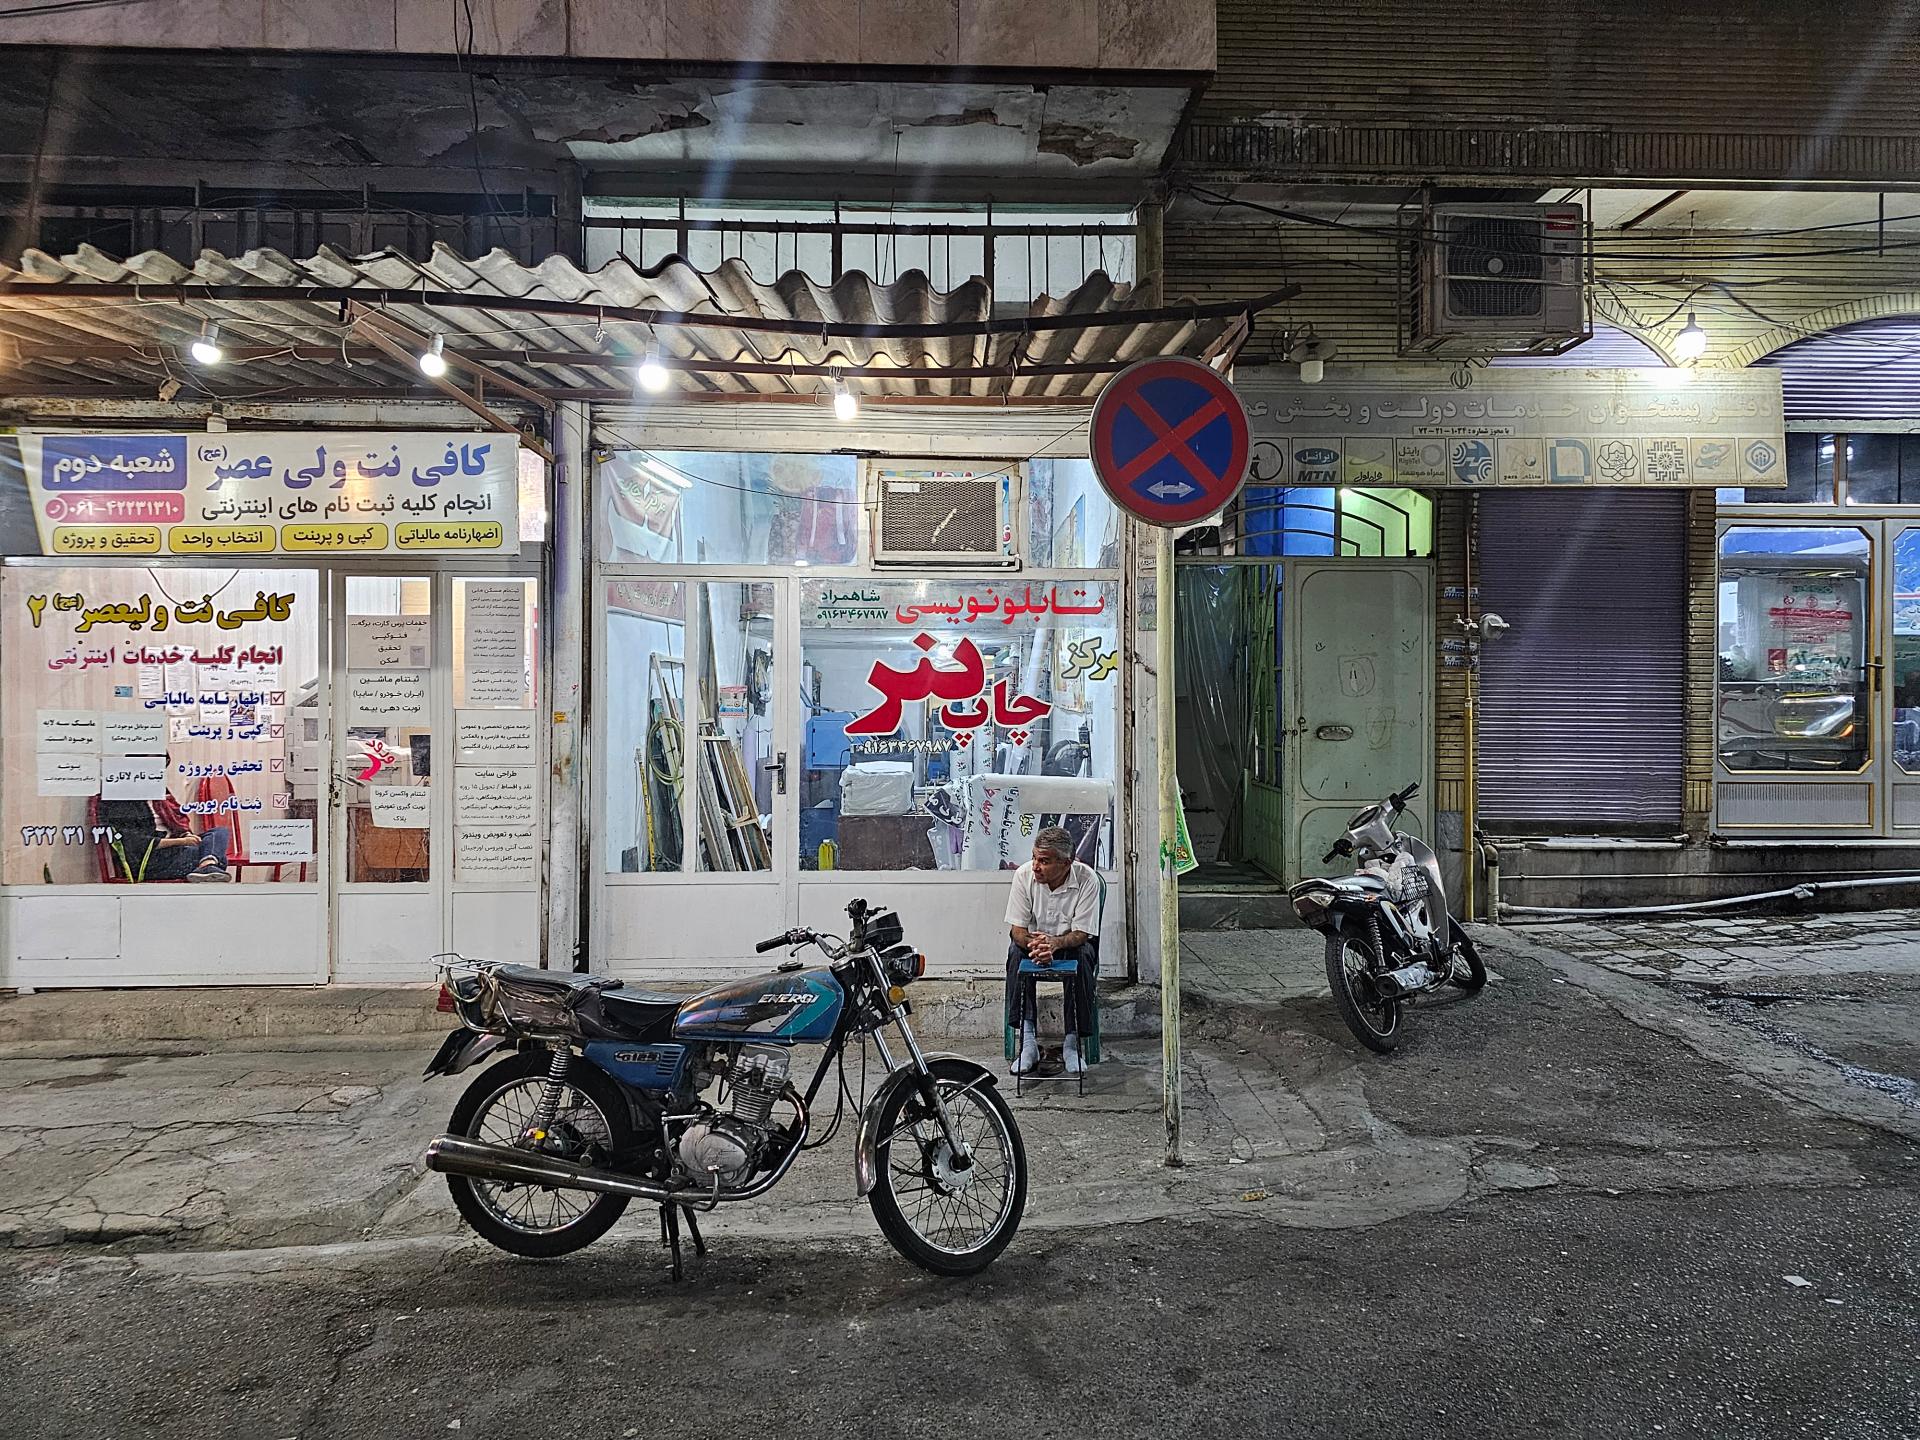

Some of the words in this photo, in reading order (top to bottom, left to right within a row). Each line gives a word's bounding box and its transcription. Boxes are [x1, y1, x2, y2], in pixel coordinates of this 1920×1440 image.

[1275, 396, 1351, 426] بخش
[1358, 406, 1372, 424] و
[1377, 397, 1457, 425] دولت
[1463, 397, 1580, 419] خدمات
[1587, 397, 1701, 425] پیشخوان
[1708, 401, 1773, 424] دفتر
[110, 448, 176, 480] شعبه
[357, 444, 401, 478] نت
[411, 441, 491, 487] کافی
[1301, 451, 1334, 463] ایرانسل
[53, 453, 102, 483] دوم
[206, 454, 273, 491] عصر
[283, 444, 347, 489] ولی
[1298, 471, 1337, 481] MTN
[202, 497, 273, 521] اینترنتی
[279, 497, 318, 519] های
[324, 496, 350, 519] نام
[356, 494, 395, 516] ثبت
[401, 494, 438, 517] کلیه
[443, 494, 492, 517] انجام
[62, 533, 96, 549] پروژه
[100, 537, 107, 548] و
[112, 532, 154, 548] تحقیق
[182, 532, 213, 546] واحد
[217, 531, 263, 545] انتخاب
[293, 529, 333, 546] پرینت
[337, 533, 344, 544] و
[348, 527, 374, 545] کپی
[399, 528, 440, 544] مالیاتی
[820, 589, 881, 603] شاهمراد
[27, 593, 47, 628] ۲
[175, 593, 214, 624] نت
[217, 591, 295, 630] کافی
[895, 587, 1105, 625] تابلونویسی
[48, 645, 115, 670] اینترنتی
[122, 645, 185, 666] خدمات
[189, 644, 236, 669] کلیه
[236, 644, 283, 671] انجام
[380, 657, 399, 665] اسکن
[359, 675, 393, 684] ماشین
[144, 691, 195, 709] مالیاتی
[380, 690, 402, 698] خودرو
[359, 704, 378, 713] بیمه
[380, 704, 400, 713] دهی
[402, 704, 421, 713] نوبت
[940, 679, 1052, 748] چاپ
[188, 724, 222, 741] پرینت
[227, 729, 234, 739] و
[239, 724, 264, 741] کپی
[365, 740, 395, 764] ورود
[133, 771, 146, 782] نام
[148, 771, 164, 782] ثبت
[178, 761, 214, 777] پروژه
[217, 766, 224, 775] و
[227, 761, 263, 775] تحقیق
[475, 770, 495, 778] سایت
[497, 770, 517, 778] طراحی
[181, 799, 217, 814] بورس
[221, 797, 238, 812] نام
[21, 826, 57, 845] ۴۲۲
[62, 826, 84, 845] ۳۱
[91, 826, 122, 845] ۳۱۰
